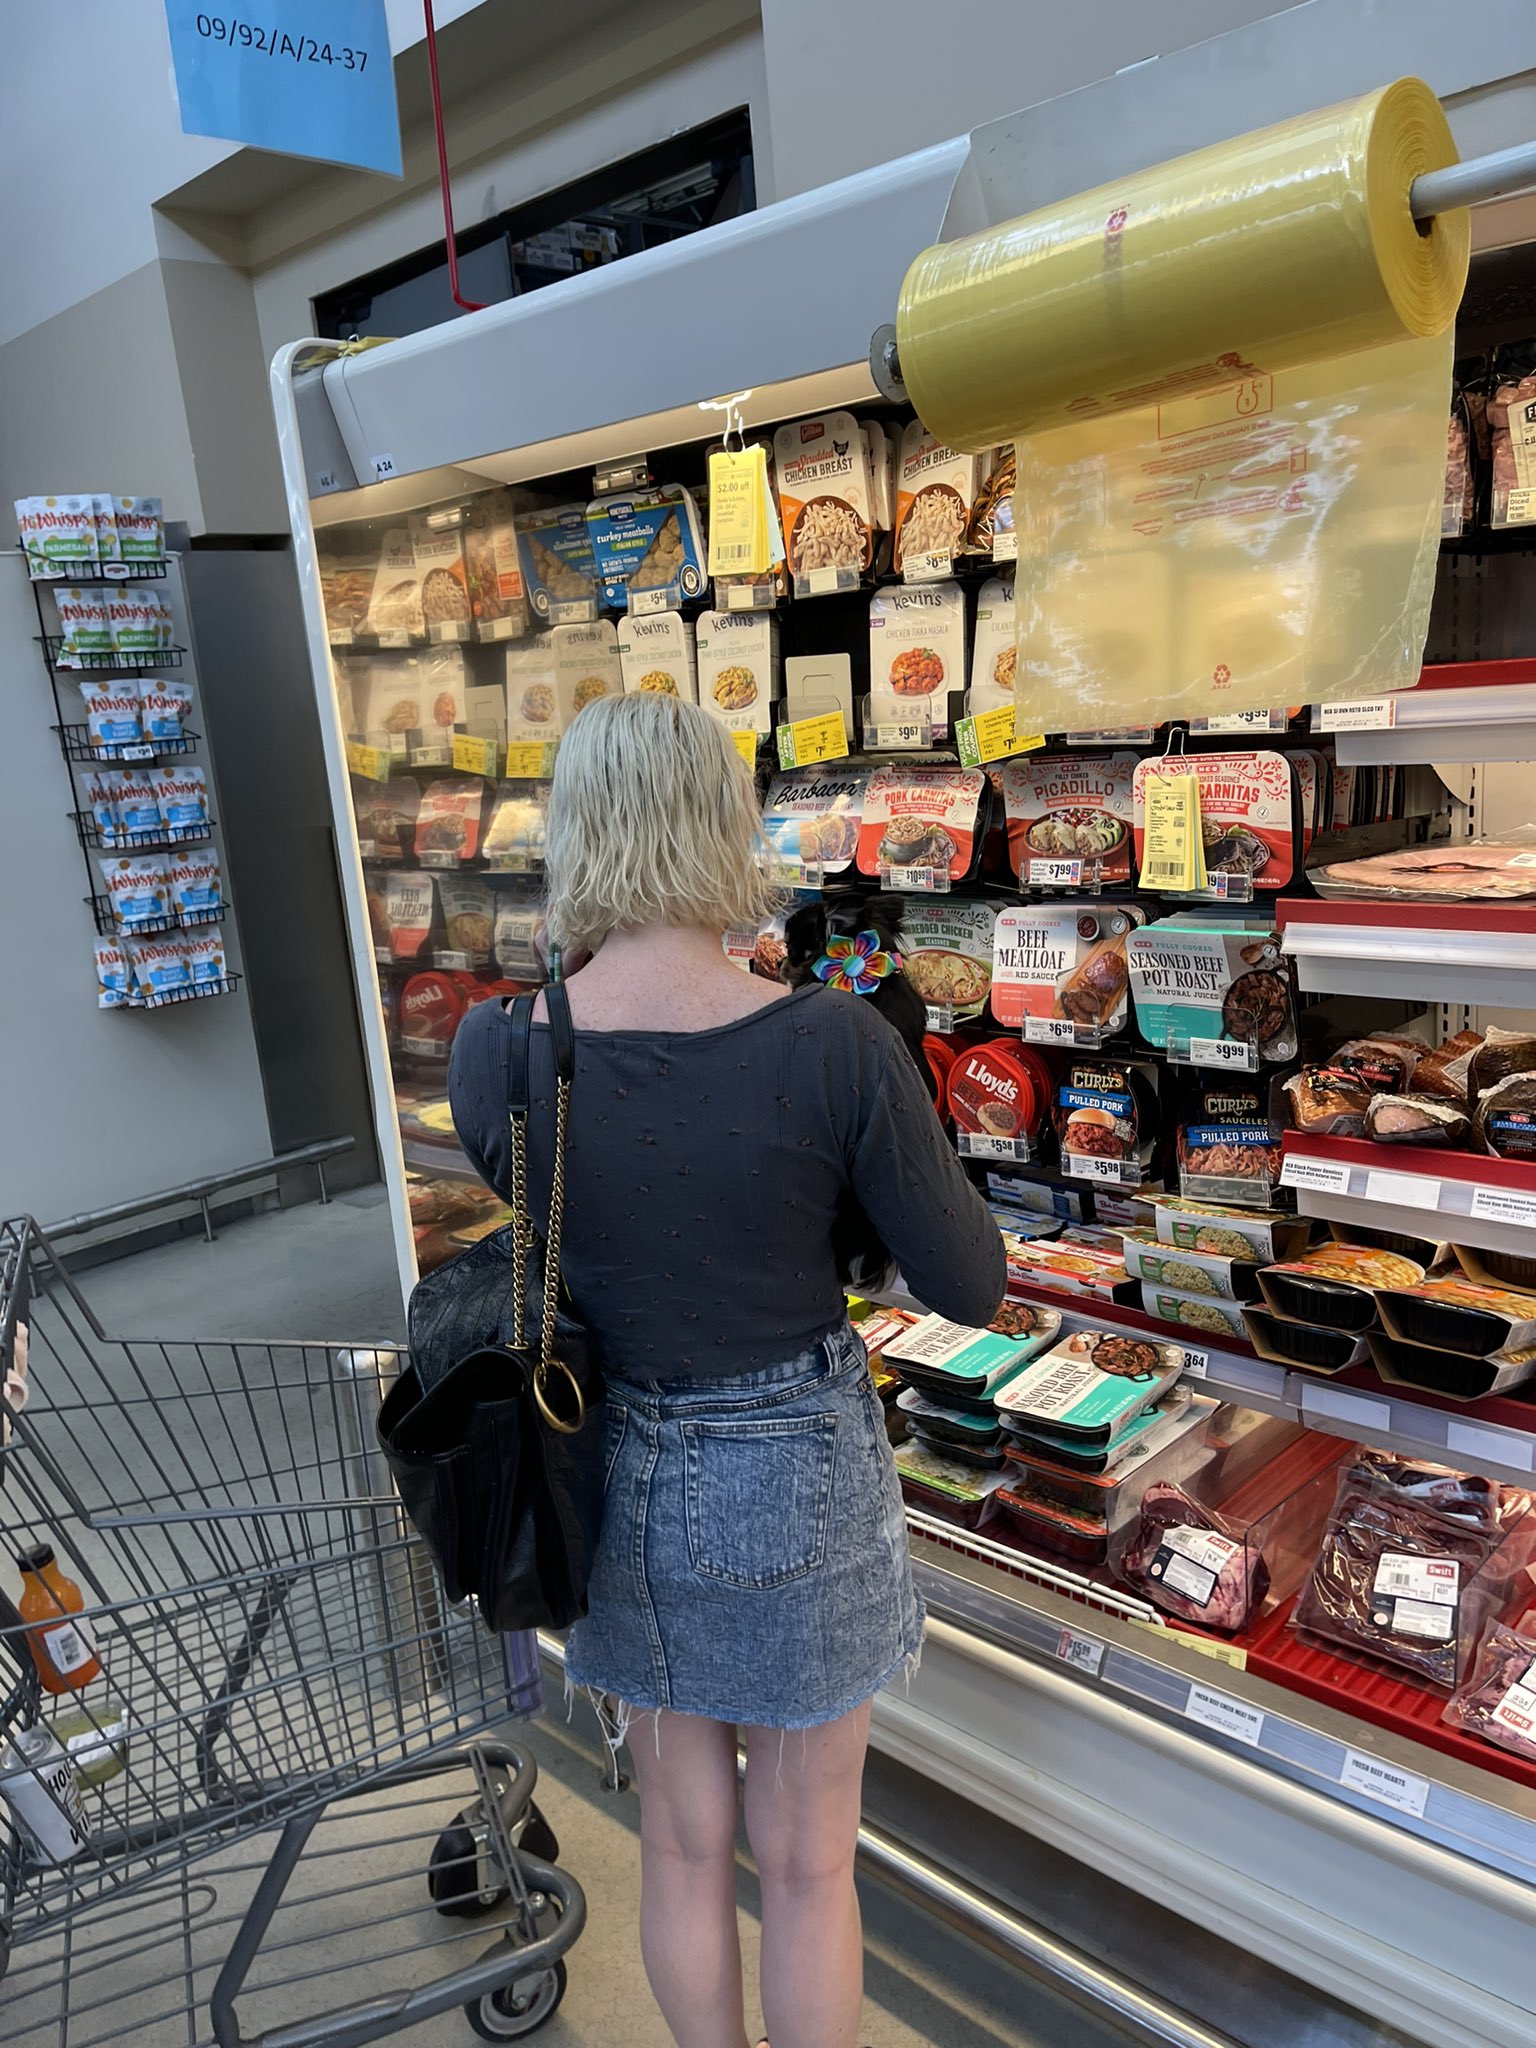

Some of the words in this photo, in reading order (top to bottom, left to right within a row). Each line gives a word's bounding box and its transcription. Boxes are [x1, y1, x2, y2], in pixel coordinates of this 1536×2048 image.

[196, 14, 368, 72] 09/92/A/24-37
[784, 464, 818, 483] CHICKEN
[820, 457, 853, 476] BREAST
[903, 454, 931, 478] CHICKEN
[933, 447, 960, 464] BREA
[717, 482, 739, 493] $2.00
[740, 481, 750, 491] off
[36, 512, 89, 529] Whisps
[597, 531, 622, 544] turkey
[622, 525, 654, 539] meatballs
[892, 590, 942, 610] kevin's
[109, 604, 158, 621] Whisps
[633, 620, 670, 638] kevin's
[711, 614, 754, 633] kevin's
[899, 726, 919, 740] $967
[1215, 775, 1240, 783] SEASONED
[774, 778, 858, 806] Barbacoa
[884, 790, 908, 806] PORK
[911, 788, 957, 807] CARNITAS
[1033, 780, 1115, 800] PICADILLO
[1199, 783, 1260, 803] CARNITAS
[1049, 862, 1071, 878] $799
[941, 923, 973, 939] CHICKEN
[1017, 929, 1049, 949] BEEF
[925, 938, 949, 946] SEASONED
[1156, 942, 1179, 950] FULLY
[1182, 944, 1213, 952] COOKED
[998, 948, 1066, 969] MEATLOAF
[1130, 952, 1191, 970] SEASONED
[1194, 956, 1224, 973] BEEF
[1015, 971, 1029, 979] RED
[1030, 972, 1055, 980] SAUCE
[1142, 969, 1171, 986] POT
[1176, 971, 1217, 991] ROAST
[1156, 989, 1191, 998] NATURAL
[1193, 991, 1219, 1000] JUICES
[1049, 1022, 1073, 1036] $699
[1216, 1043, 1244, 1059] $999
[965, 1059, 1018, 1101] Lloyd's
[1069, 1094, 1100, 1108] PULLED
[1101, 1101, 1123, 1112] PORK
[991, 1139, 1012, 1152] $558
[1201, 1132, 1239, 1143] PULLED
[1242, 1131, 1269, 1141] PORK
[1095, 1161, 1119, 1175] $598
[1306, 1165, 1322, 1173] Pepper
[1513, 1204, 1530, 1212] Natural
[1021, 1272, 1039, 1281] Evans
[1184, 1352, 1205, 1368] 364
[1011, 1374, 1057, 1409] SEASONED
[1052, 1361, 1080, 1385] BEEF
[1034, 1390, 1062, 1411] POT
[1059, 1370, 1091, 1397] ROAST
[1208, 1536, 1233, 1552] Swift
[1428, 1565, 1453, 1577] Swift
[1504, 1708, 1530, 1728] Swift
[1352, 1759, 1370, 1772] FRESH
[1370, 1766, 1383, 1777] BEEF
[1384, 1772, 1406, 1787] HEARTS
